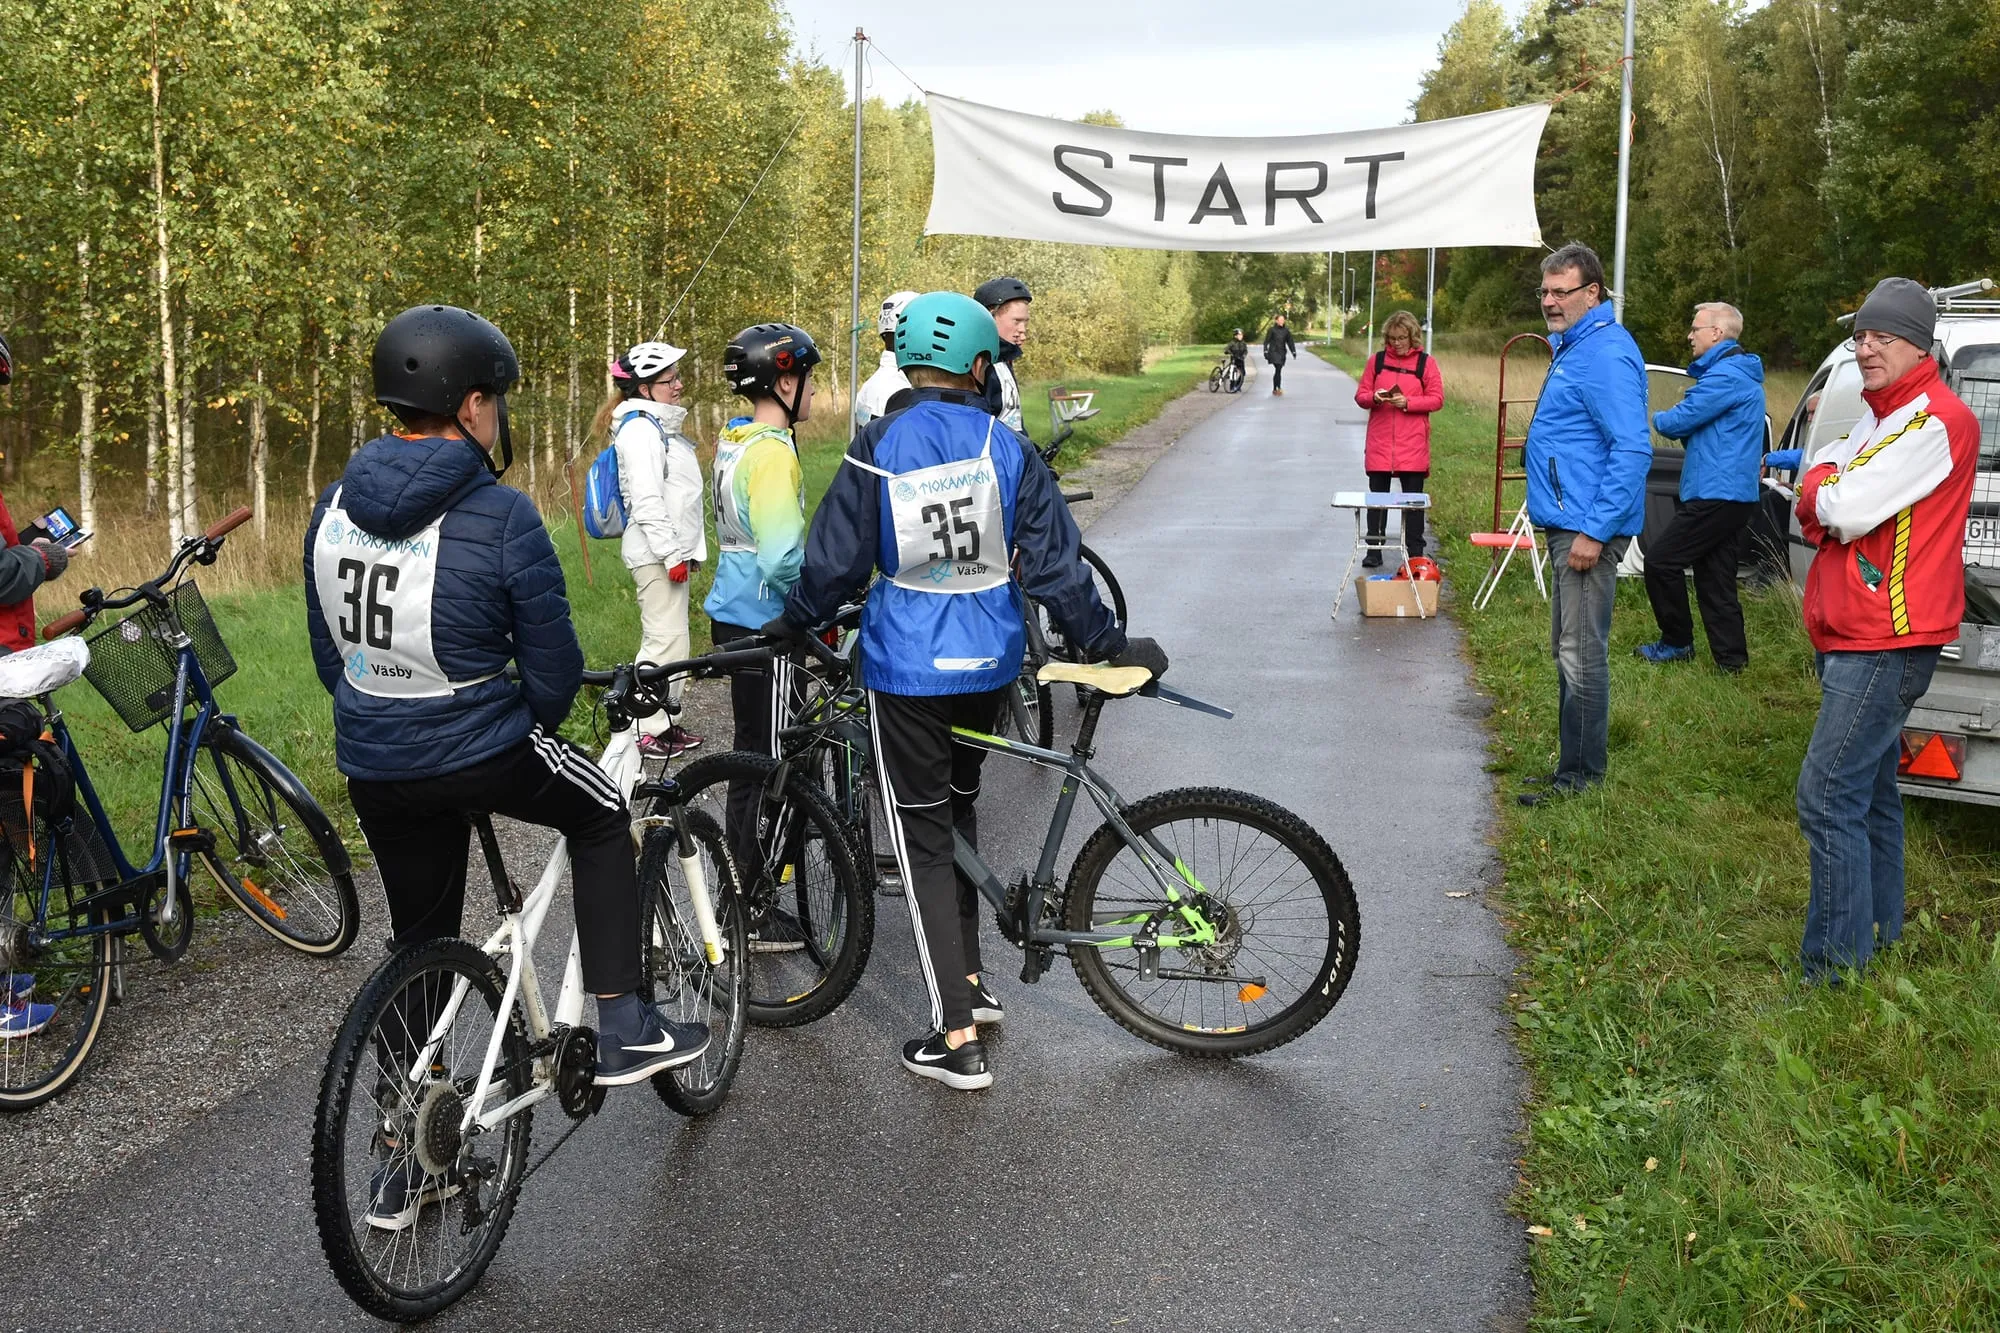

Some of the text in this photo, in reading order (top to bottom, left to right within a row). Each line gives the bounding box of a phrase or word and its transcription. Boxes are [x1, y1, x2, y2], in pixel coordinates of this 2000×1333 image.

[1053, 144, 1405, 226] START
[919, 470, 990, 495] TIOKAMPEN
[921, 496, 980, 561] 35
[1969, 520, 2000, 539] GH
[957, 563, 989, 576] Väsby
[337, 557, 400, 651] 36
[371, 664, 413, 679] Väsby
[1321, 920, 1345, 996] KENDA
[486, 969, 524, 1036] MEDA
